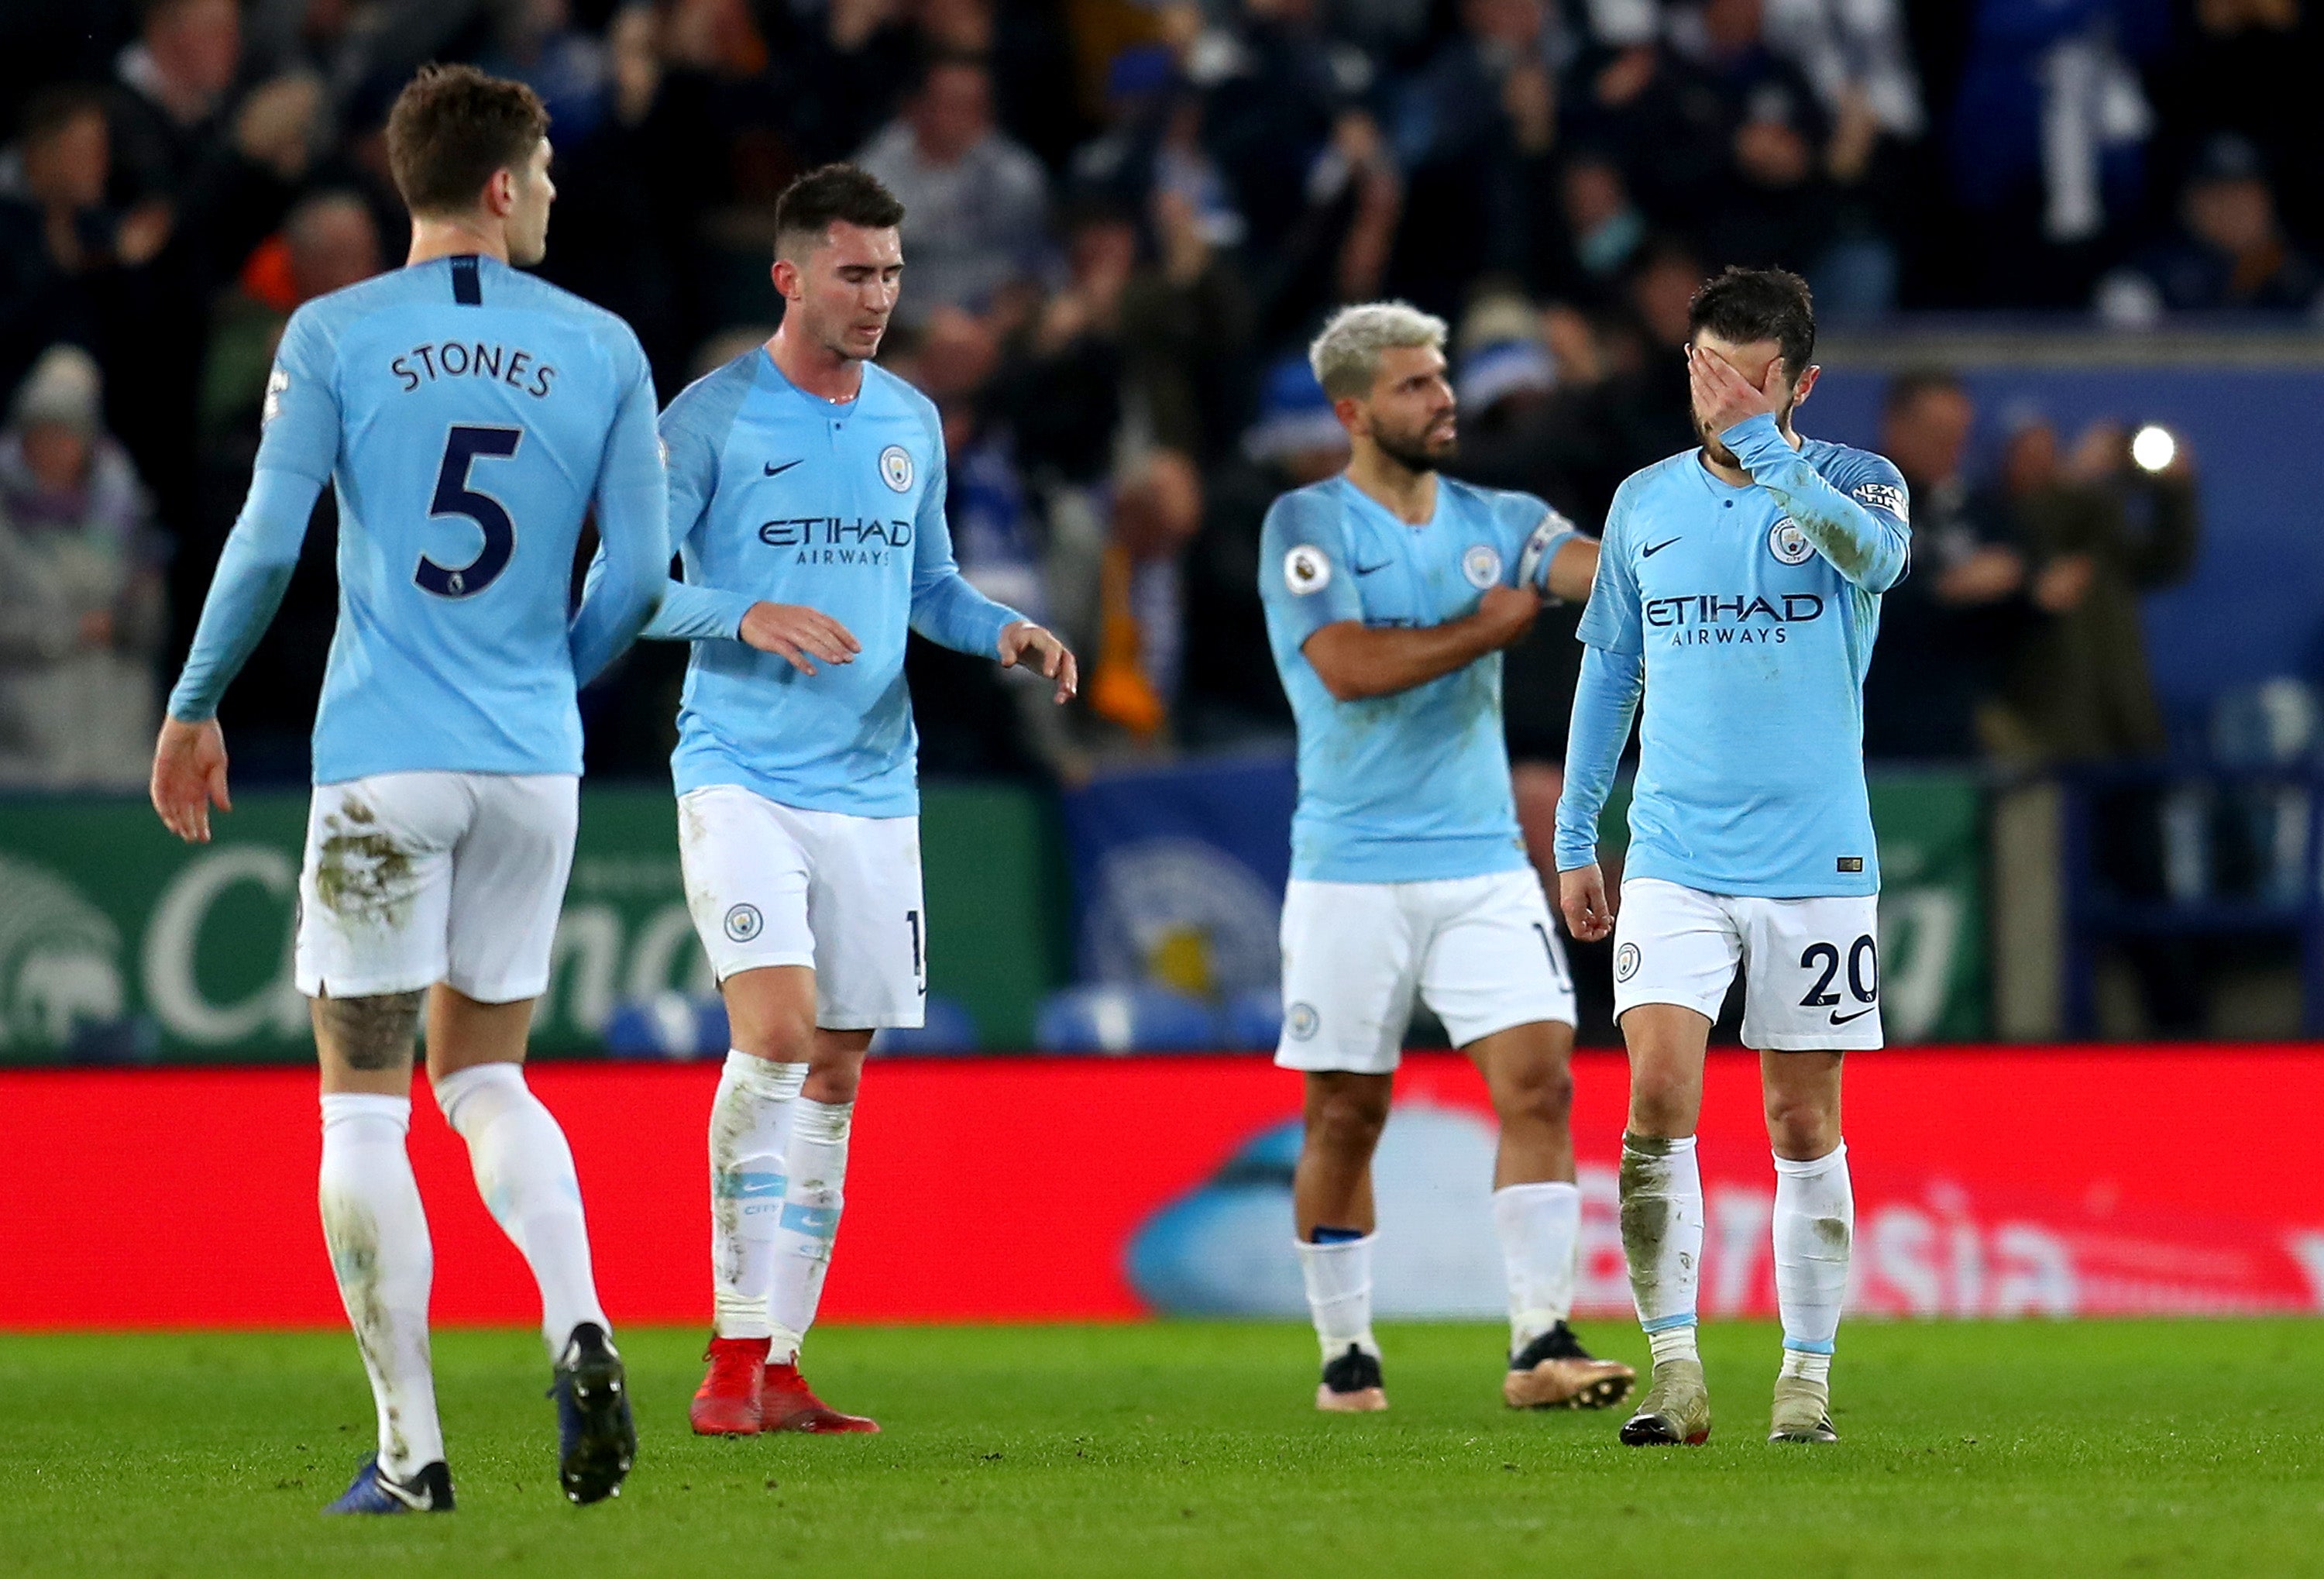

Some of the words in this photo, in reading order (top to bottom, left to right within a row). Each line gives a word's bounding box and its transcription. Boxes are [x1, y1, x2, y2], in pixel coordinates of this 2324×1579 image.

[391, 342, 555, 397] STONES
[414, 425, 522, 598] 5
[758, 518, 913, 547] ETIHAD
[1646, 594, 1824, 626] ETIHAD
[1672, 628, 1786, 646] AIRWAYS
[1799, 934, 1877, 1006] 20
